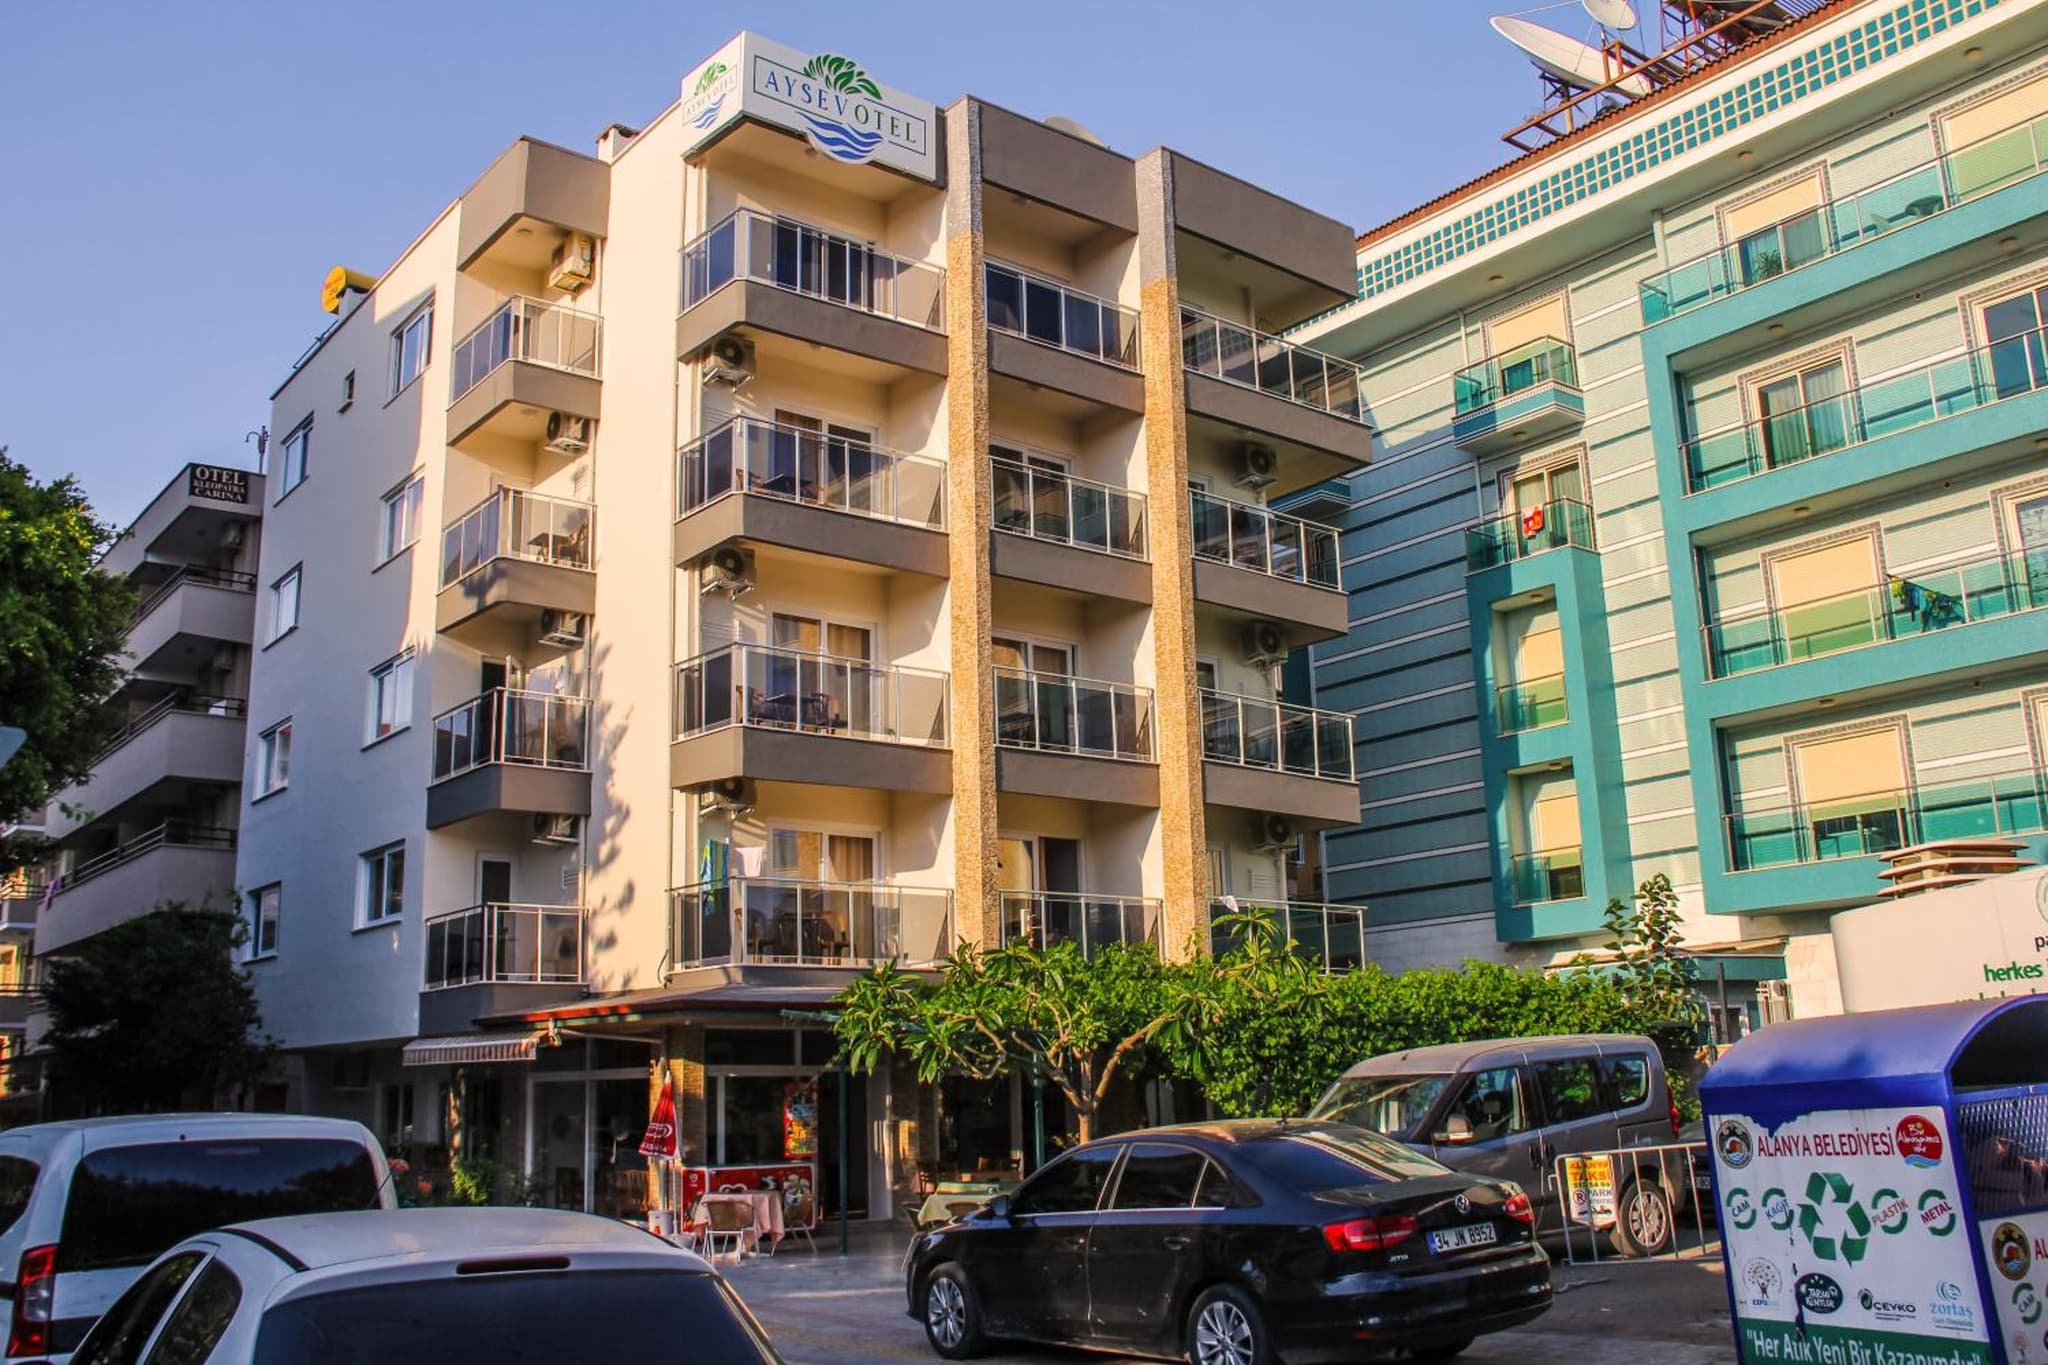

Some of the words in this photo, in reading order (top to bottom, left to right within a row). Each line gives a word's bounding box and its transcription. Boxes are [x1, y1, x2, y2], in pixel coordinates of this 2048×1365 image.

[193, 479, 246, 494] KLEOPATRA
[195, 466, 245, 486] OTEL
[194, 488, 243, 502] CARINA
[1983, 961, 2044, 982] herkes
[1758, 1134, 1812, 1157] ALANYA
[1814, 1126, 1896, 1157] BELEDİYESİ
[1731, 1200, 1750, 1218] CAM
[1871, 1198, 1910, 1226] PLASTİK
[1920, 1201, 1953, 1225] METAL
[1435, 1232, 1450, 1249] 34
[1468, 1224, 1495, 1244] 8952
[2018, 1293, 2035, 1313] CAM
[1746, 1329, 1779, 1358] "Her
[1813, 1336, 1847, 1365] Yeni
[1848, 1339, 1871, 1365] Bir
